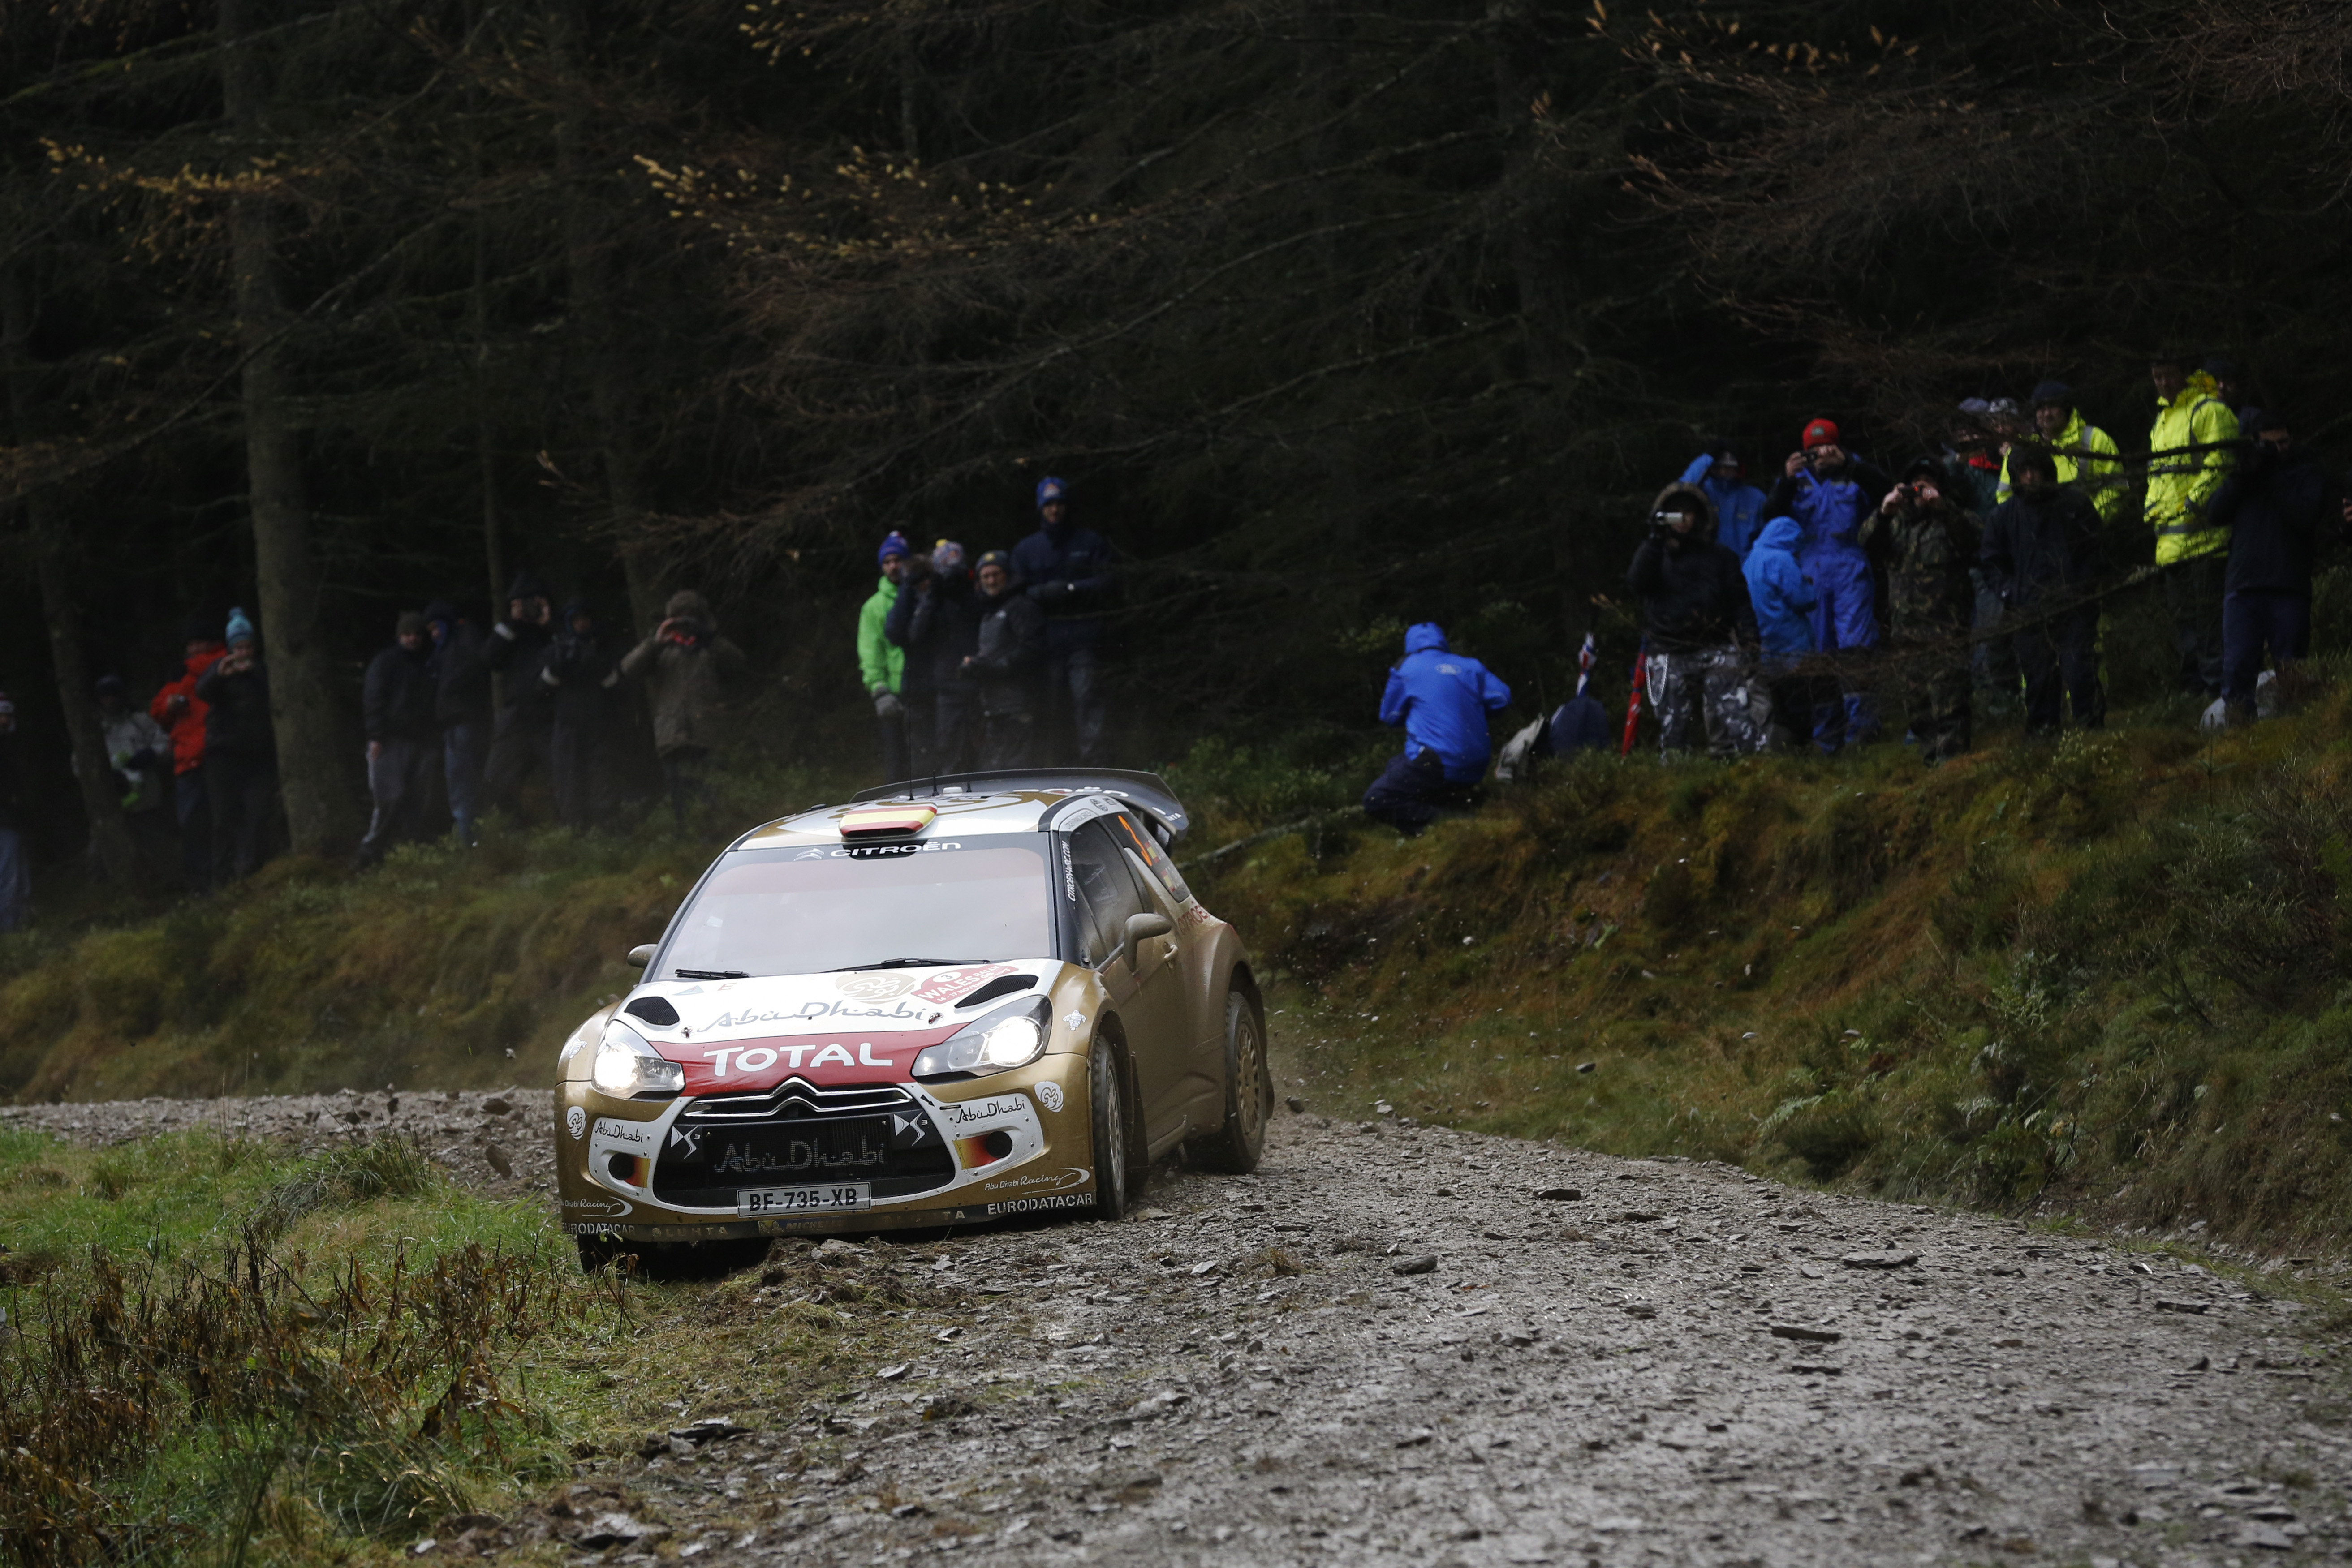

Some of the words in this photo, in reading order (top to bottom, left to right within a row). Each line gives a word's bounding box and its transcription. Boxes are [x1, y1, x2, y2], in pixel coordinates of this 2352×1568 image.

[830, 842, 961, 857] CITROËN
[918, 975, 978, 999] WALES
[973, 965, 999, 976] RALLY
[957, 976, 994, 994] NOVEMBER
[697, 1008, 795, 1033] Abu
[795, 1000, 927, 1021] Dhabi
[703, 1043, 893, 1077] TOTAL
[955, 1107, 987, 1123] Abu
[987, 1097, 1026, 1116] Dhabi
[594, 1121, 613, 1137] Abu
[613, 1125, 644, 1143] Dhabi
[714, 1142, 789, 1173] Abu
[789, 1134, 885, 1170] Dhabi
[984, 1183, 999, 1191] Abu
[999, 1179, 1019, 1189] Dhabi
[1019, 1173, 1076, 1186] Racing
[580, 1198, 620, 1213] Racing
[749, 1188, 857, 1211] BF-735-XB
[987, 1193, 1093, 1216] EURODATACAR
